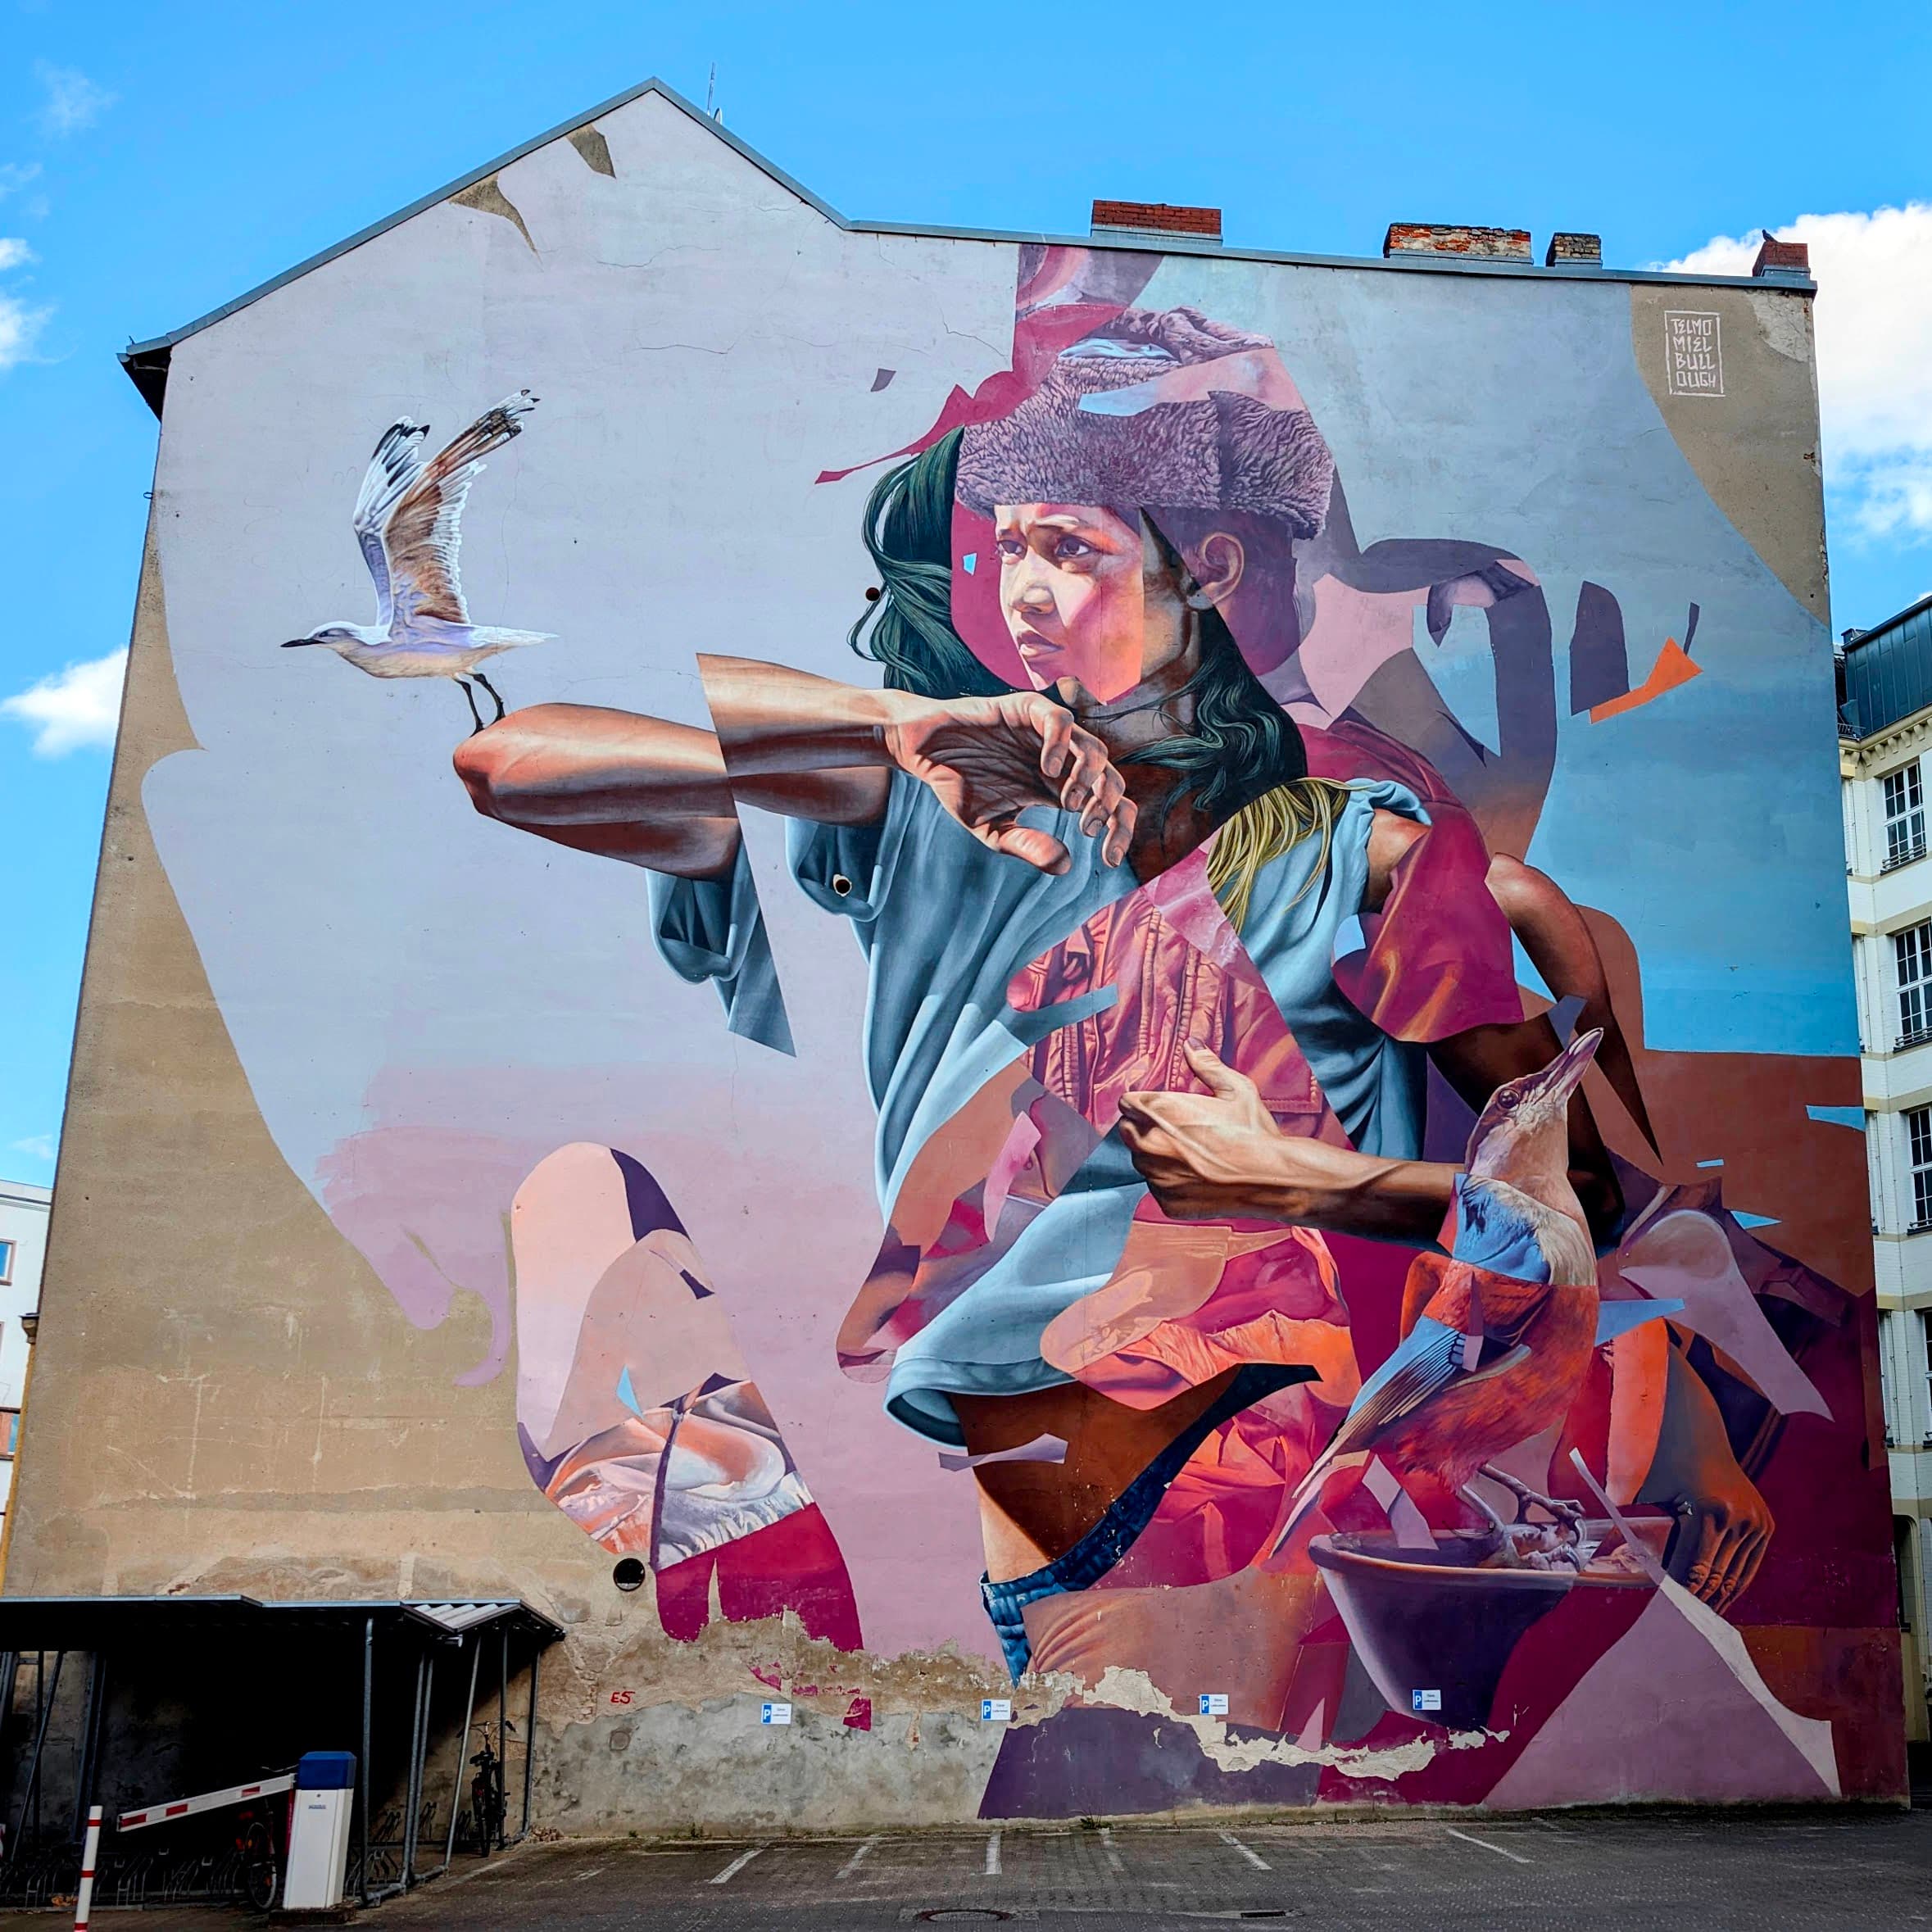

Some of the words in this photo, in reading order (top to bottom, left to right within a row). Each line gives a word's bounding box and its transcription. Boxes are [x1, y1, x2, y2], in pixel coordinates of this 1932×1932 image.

[1670, 318, 1712, 336] TELMO
[1672, 336, 1712, 352] MIEL
[1675, 352, 1716, 370] BULL
[1676, 371, 1716, 388] OUGH
[1202, 1700, 1209, 1711] P
[1415, 1695, 1422, 1706] P
[764, 1709, 771, 1720] P
[983, 1705, 991, 1716] P
